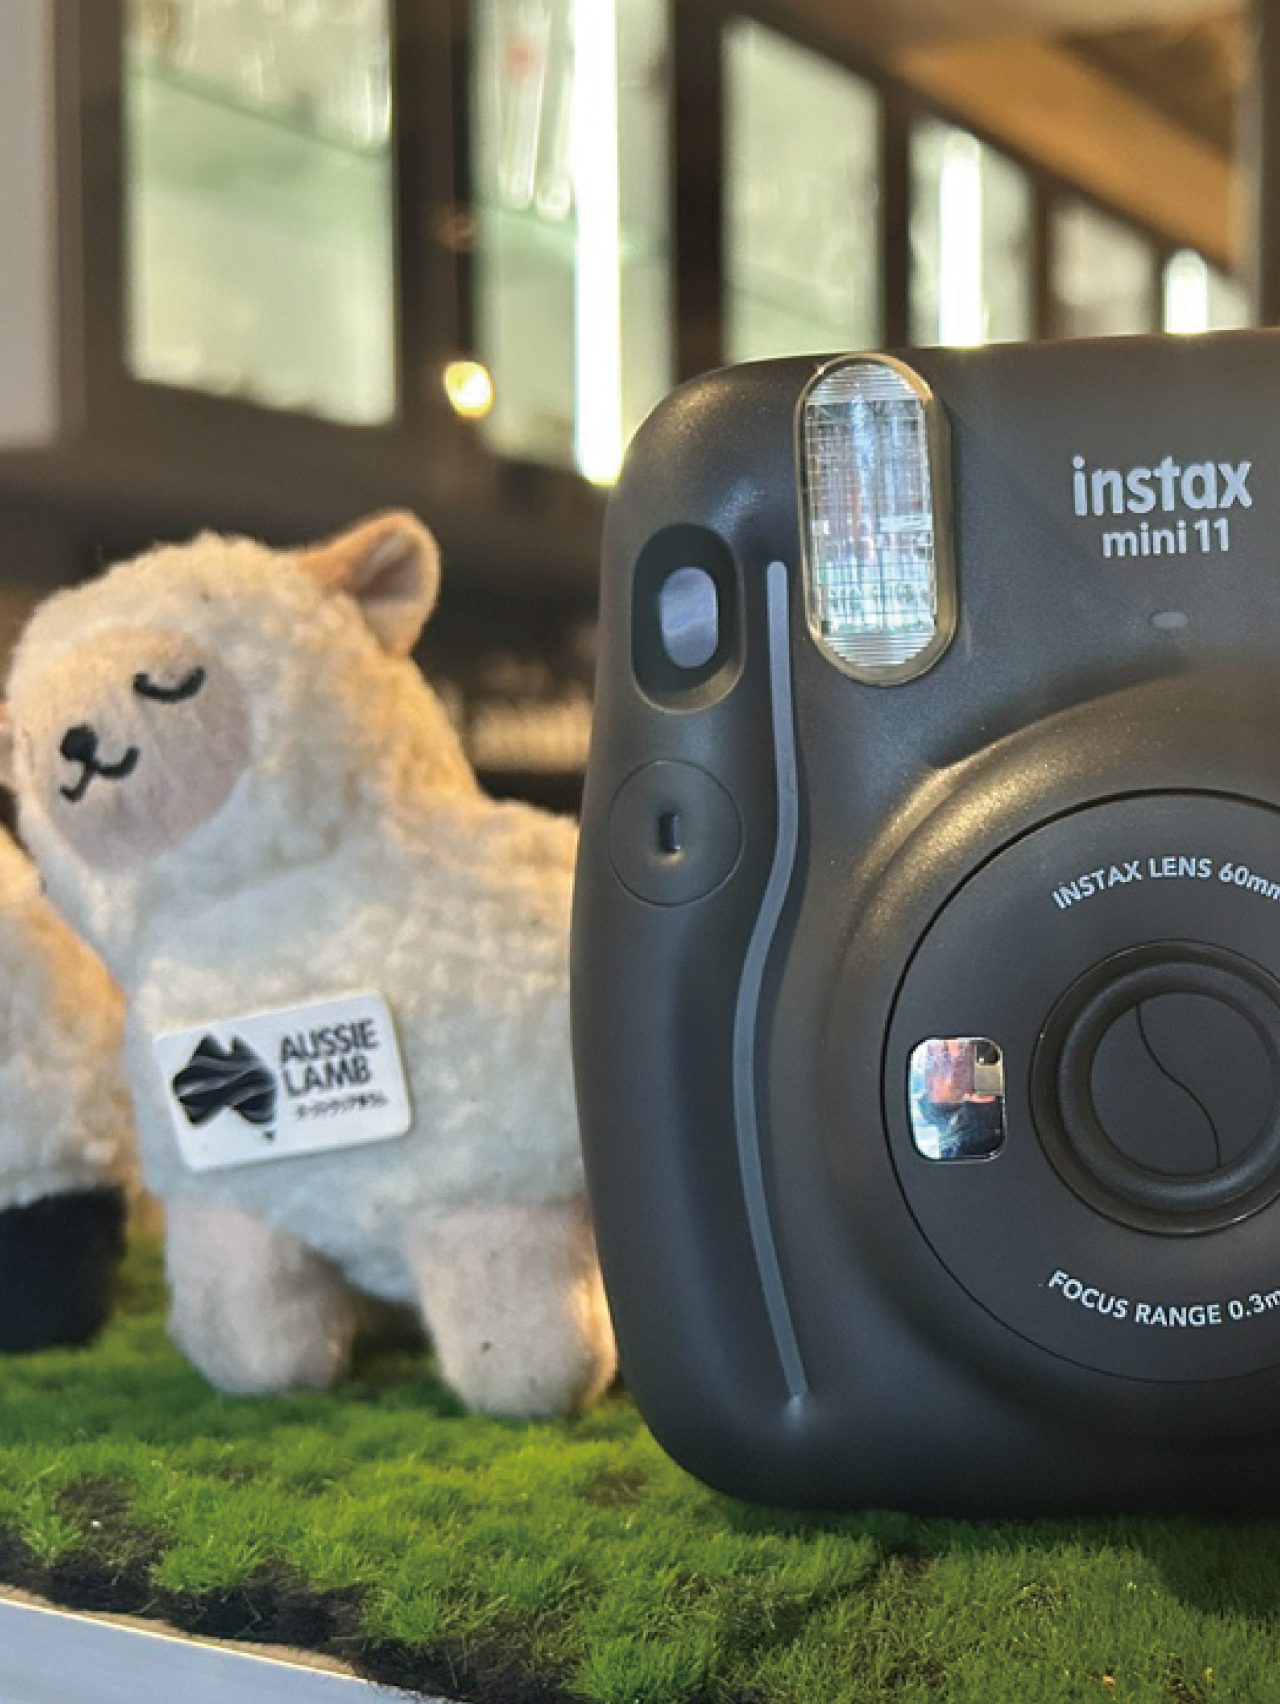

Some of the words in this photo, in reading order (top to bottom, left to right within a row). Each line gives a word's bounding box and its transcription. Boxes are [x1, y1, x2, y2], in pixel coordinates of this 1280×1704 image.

[1072, 454, 1252, 516] instax
[1102, 519, 1187, 558] mini
[1194, 517, 1229, 553] 11
[1052, 860, 1142, 909] INSTAX
[1149, 855, 1213, 878] LENS
[280, 1019, 379, 1063] AUSSIE
[283, 1055, 371, 1097] LAMB
[1049, 1270, 1129, 1318] FOCUS
[1135, 1303, 1222, 1327] RANGE
